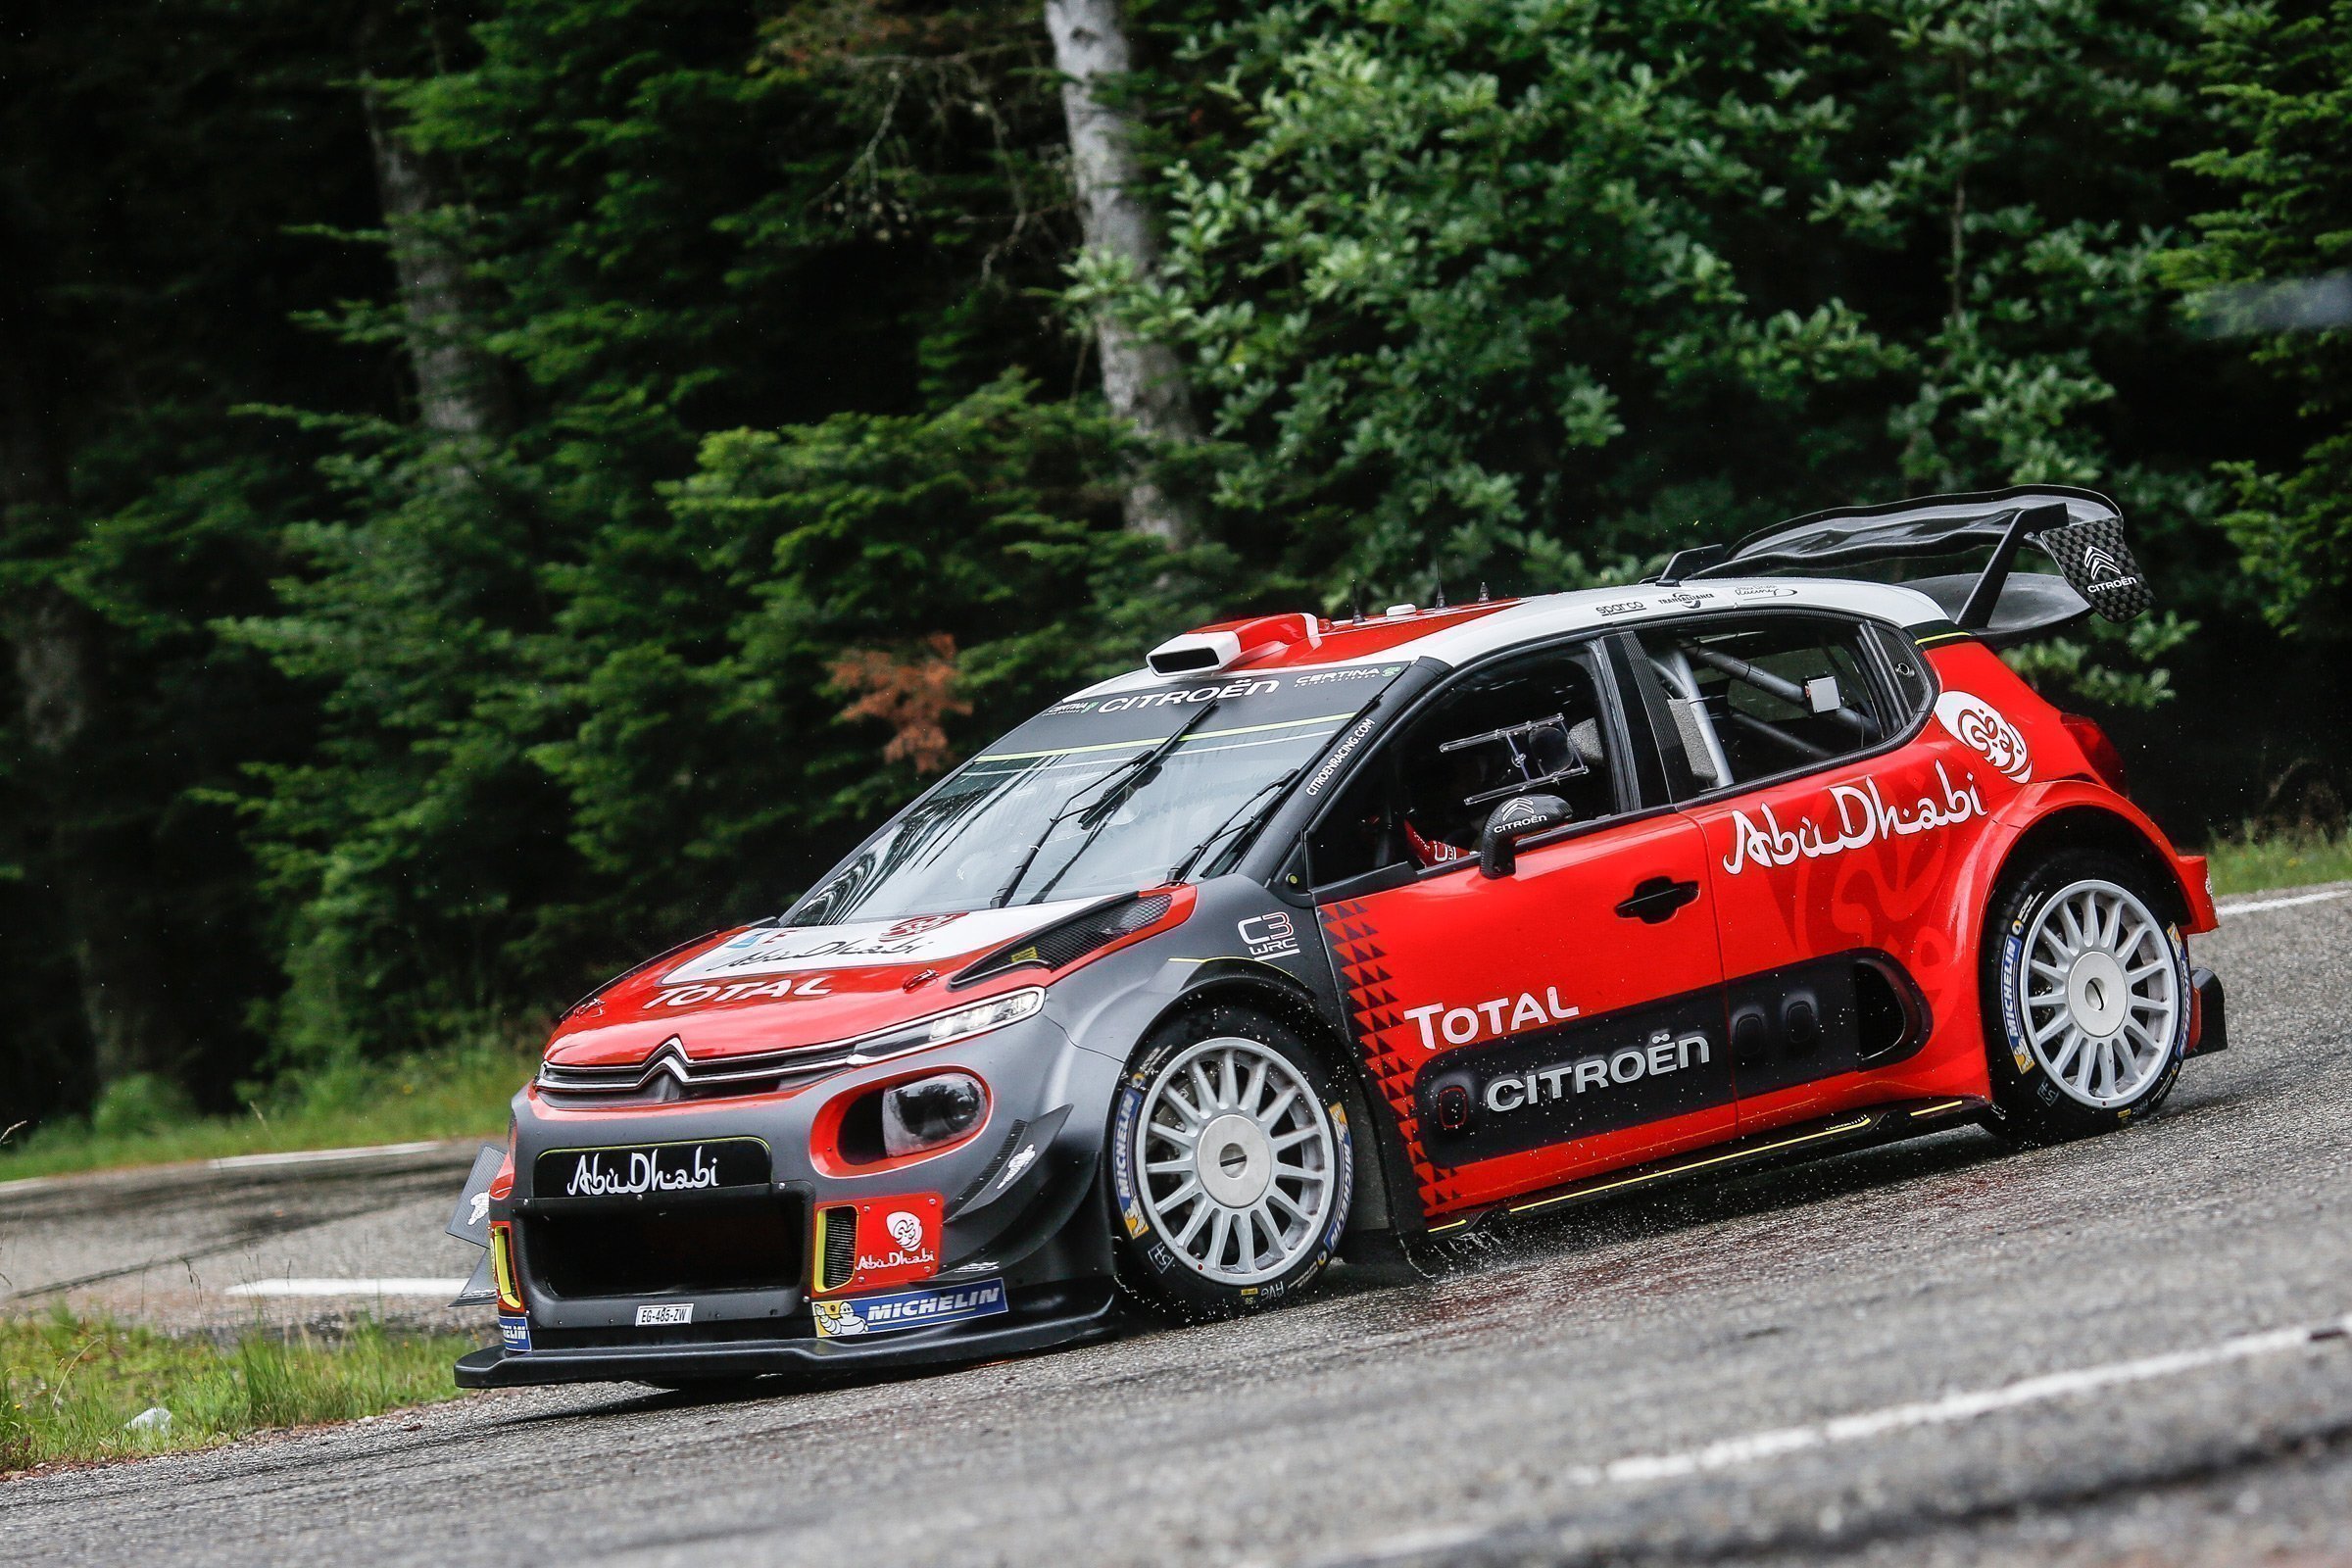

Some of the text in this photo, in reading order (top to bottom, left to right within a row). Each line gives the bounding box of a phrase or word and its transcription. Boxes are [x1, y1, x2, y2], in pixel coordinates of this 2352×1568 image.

[1595, 601, 1644, 615] sparco
[1658, 593, 1715, 605] TRANSALLIANCE
[1297, 667, 1380, 684] CERTINA
[1305, 717, 1376, 796] CITROENRACING.COM
[1237, 911, 1295, 945] C3
[1249, 937, 1298, 956] WRC
[642, 978, 832, 1010] TOTAL
[2003, 940, 2019, 1037] MICHELIN
[1403, 986, 1580, 1050] TOTAL
[1115, 1093, 1135, 1198] MICHELIN
[1331, 1144, 1351, 1248] MICHELIN
[867, 1287, 1001, 1322] MICHELIN
